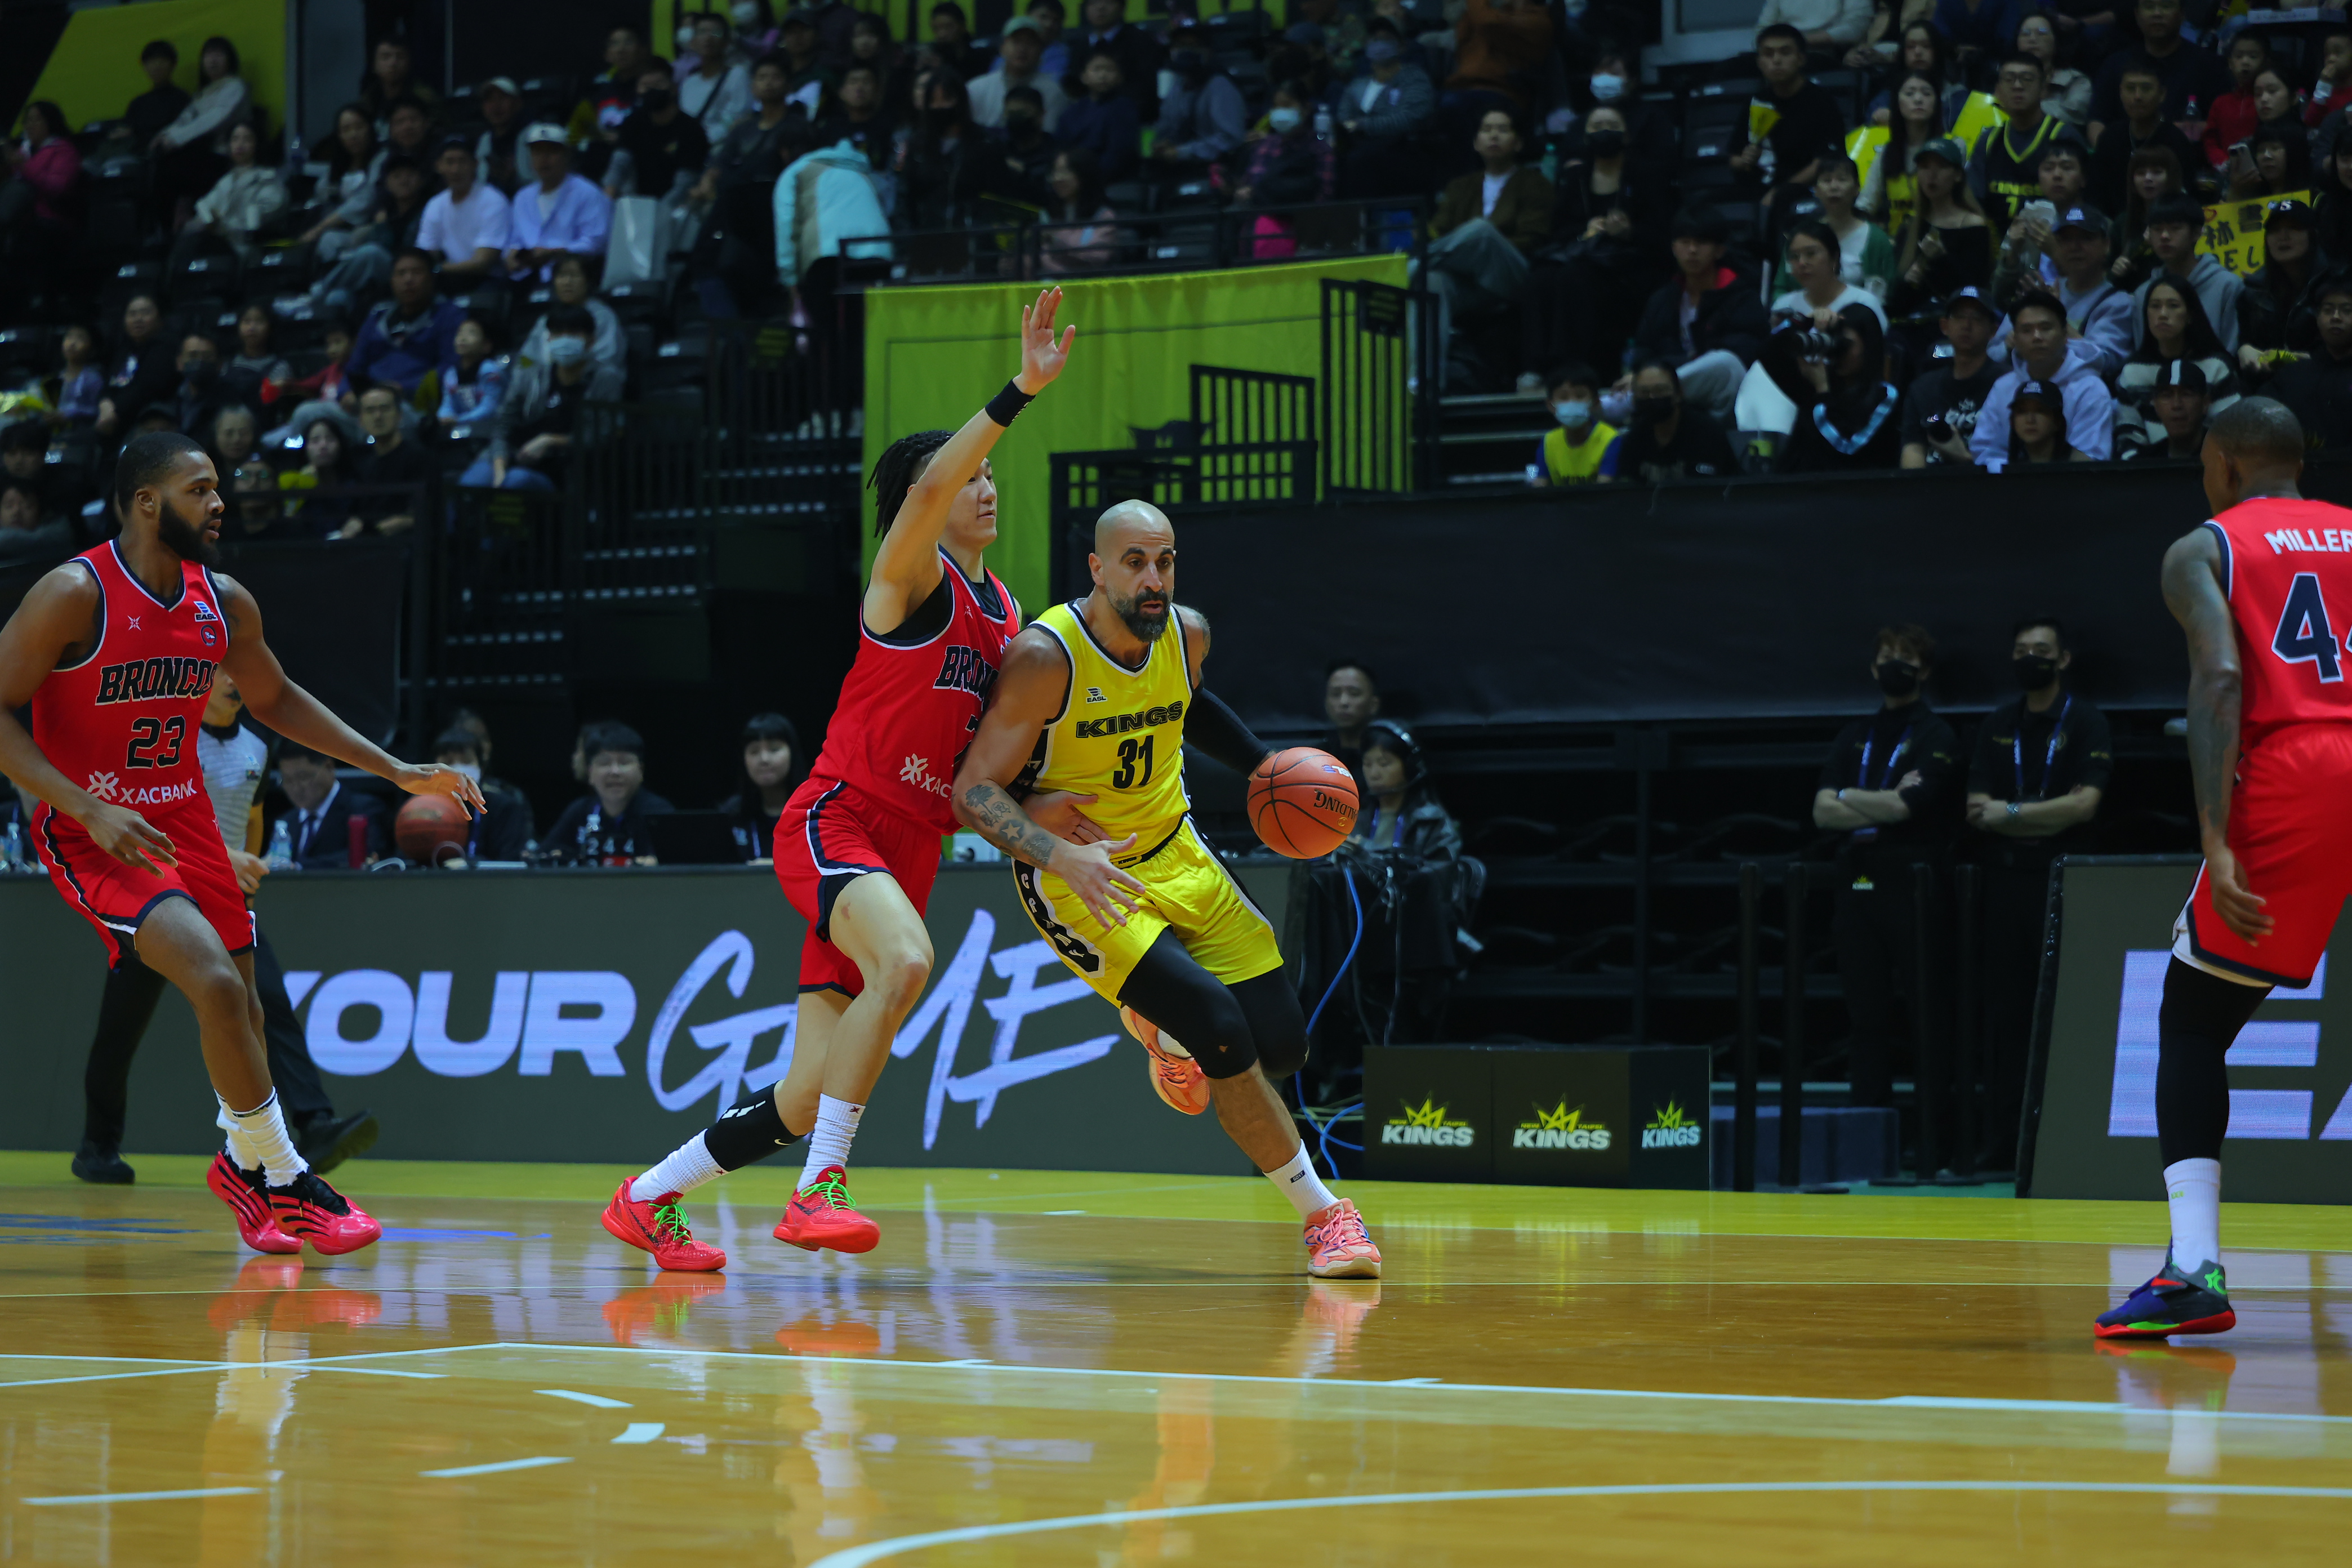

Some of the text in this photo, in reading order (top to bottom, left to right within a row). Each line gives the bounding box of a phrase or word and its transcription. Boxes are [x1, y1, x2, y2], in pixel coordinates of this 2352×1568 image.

[2271, 572, 2352, 684] 4
[1076, 701, 1183, 738] KINGS
[125, 715, 186, 769] 23
[1113, 735, 1154, 789] 31
[119, 778, 197, 804] XACBANK
[1381, 1124, 1475, 1147] KINGS
[1513, 1128, 1611, 1150] KINGS
[1641, 1125, 1701, 1149] KINGS
